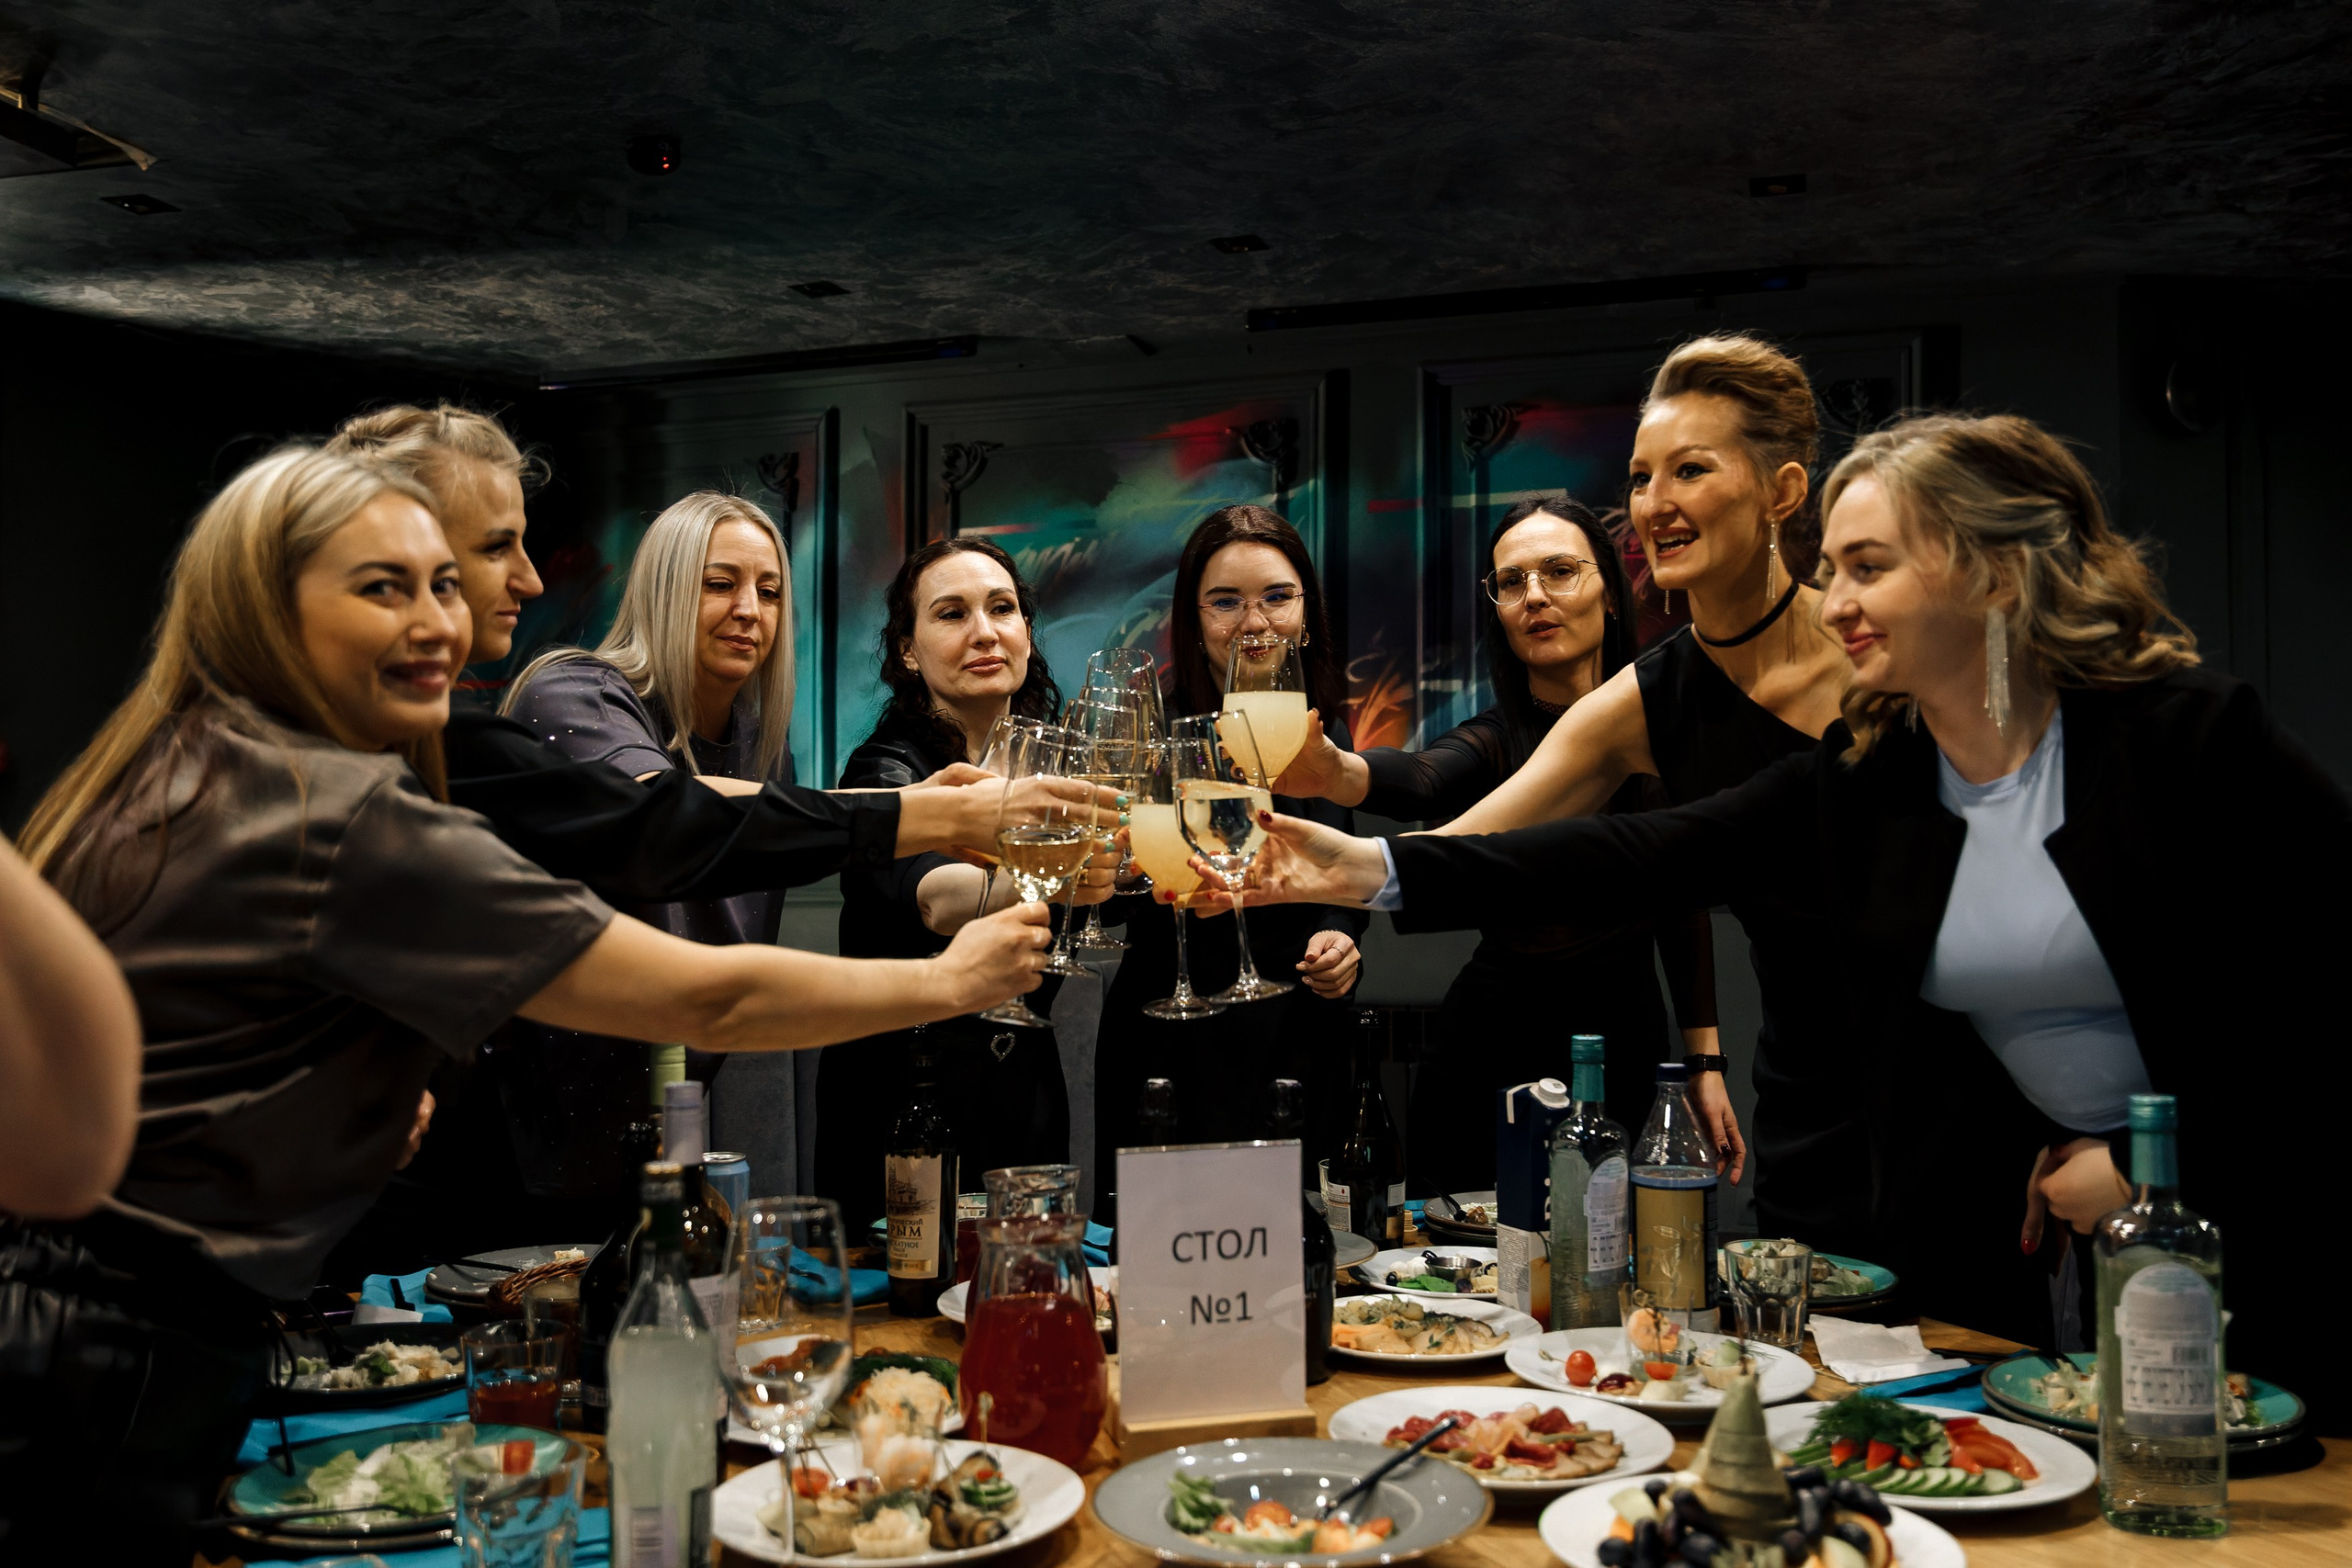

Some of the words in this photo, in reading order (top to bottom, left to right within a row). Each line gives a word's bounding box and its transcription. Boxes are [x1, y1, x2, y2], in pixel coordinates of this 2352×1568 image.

[888, 1224, 922, 1236] РЫМ
[1171, 1226, 1268, 1264] СТОЛ
[1190, 1291, 1253, 1325] №1
